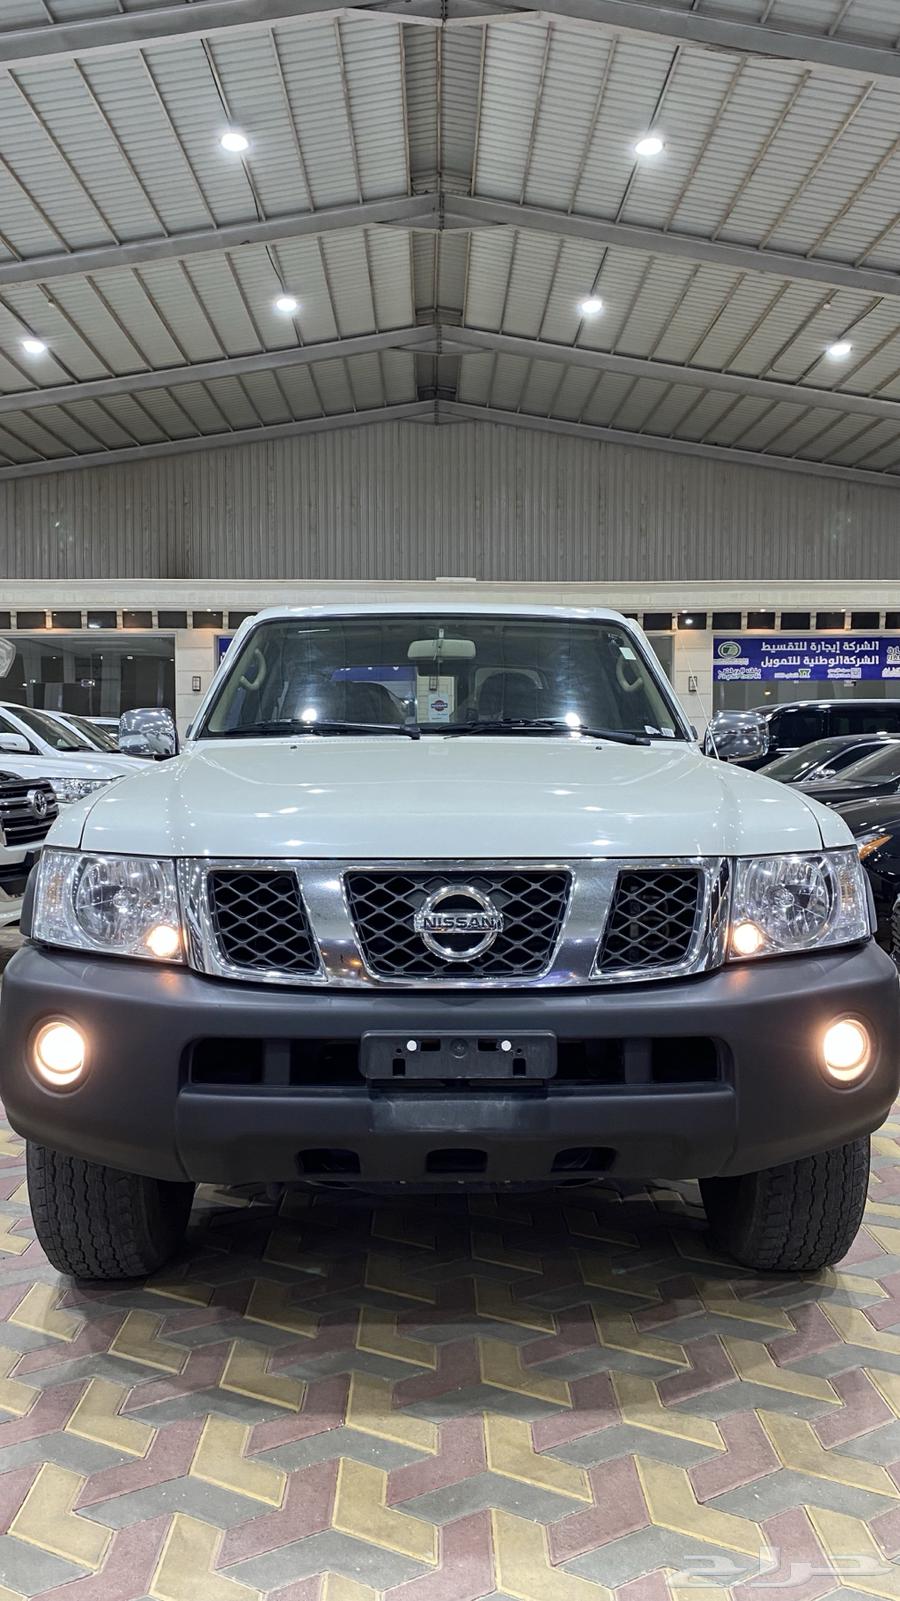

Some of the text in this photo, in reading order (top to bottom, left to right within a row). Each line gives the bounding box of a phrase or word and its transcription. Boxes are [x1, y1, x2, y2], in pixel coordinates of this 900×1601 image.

[761, 641, 879, 653] الشركة إيجارة للتقسيط
[761, 656, 800, 667] للتمويل
[423, 917, 495, 929] NISSAN
